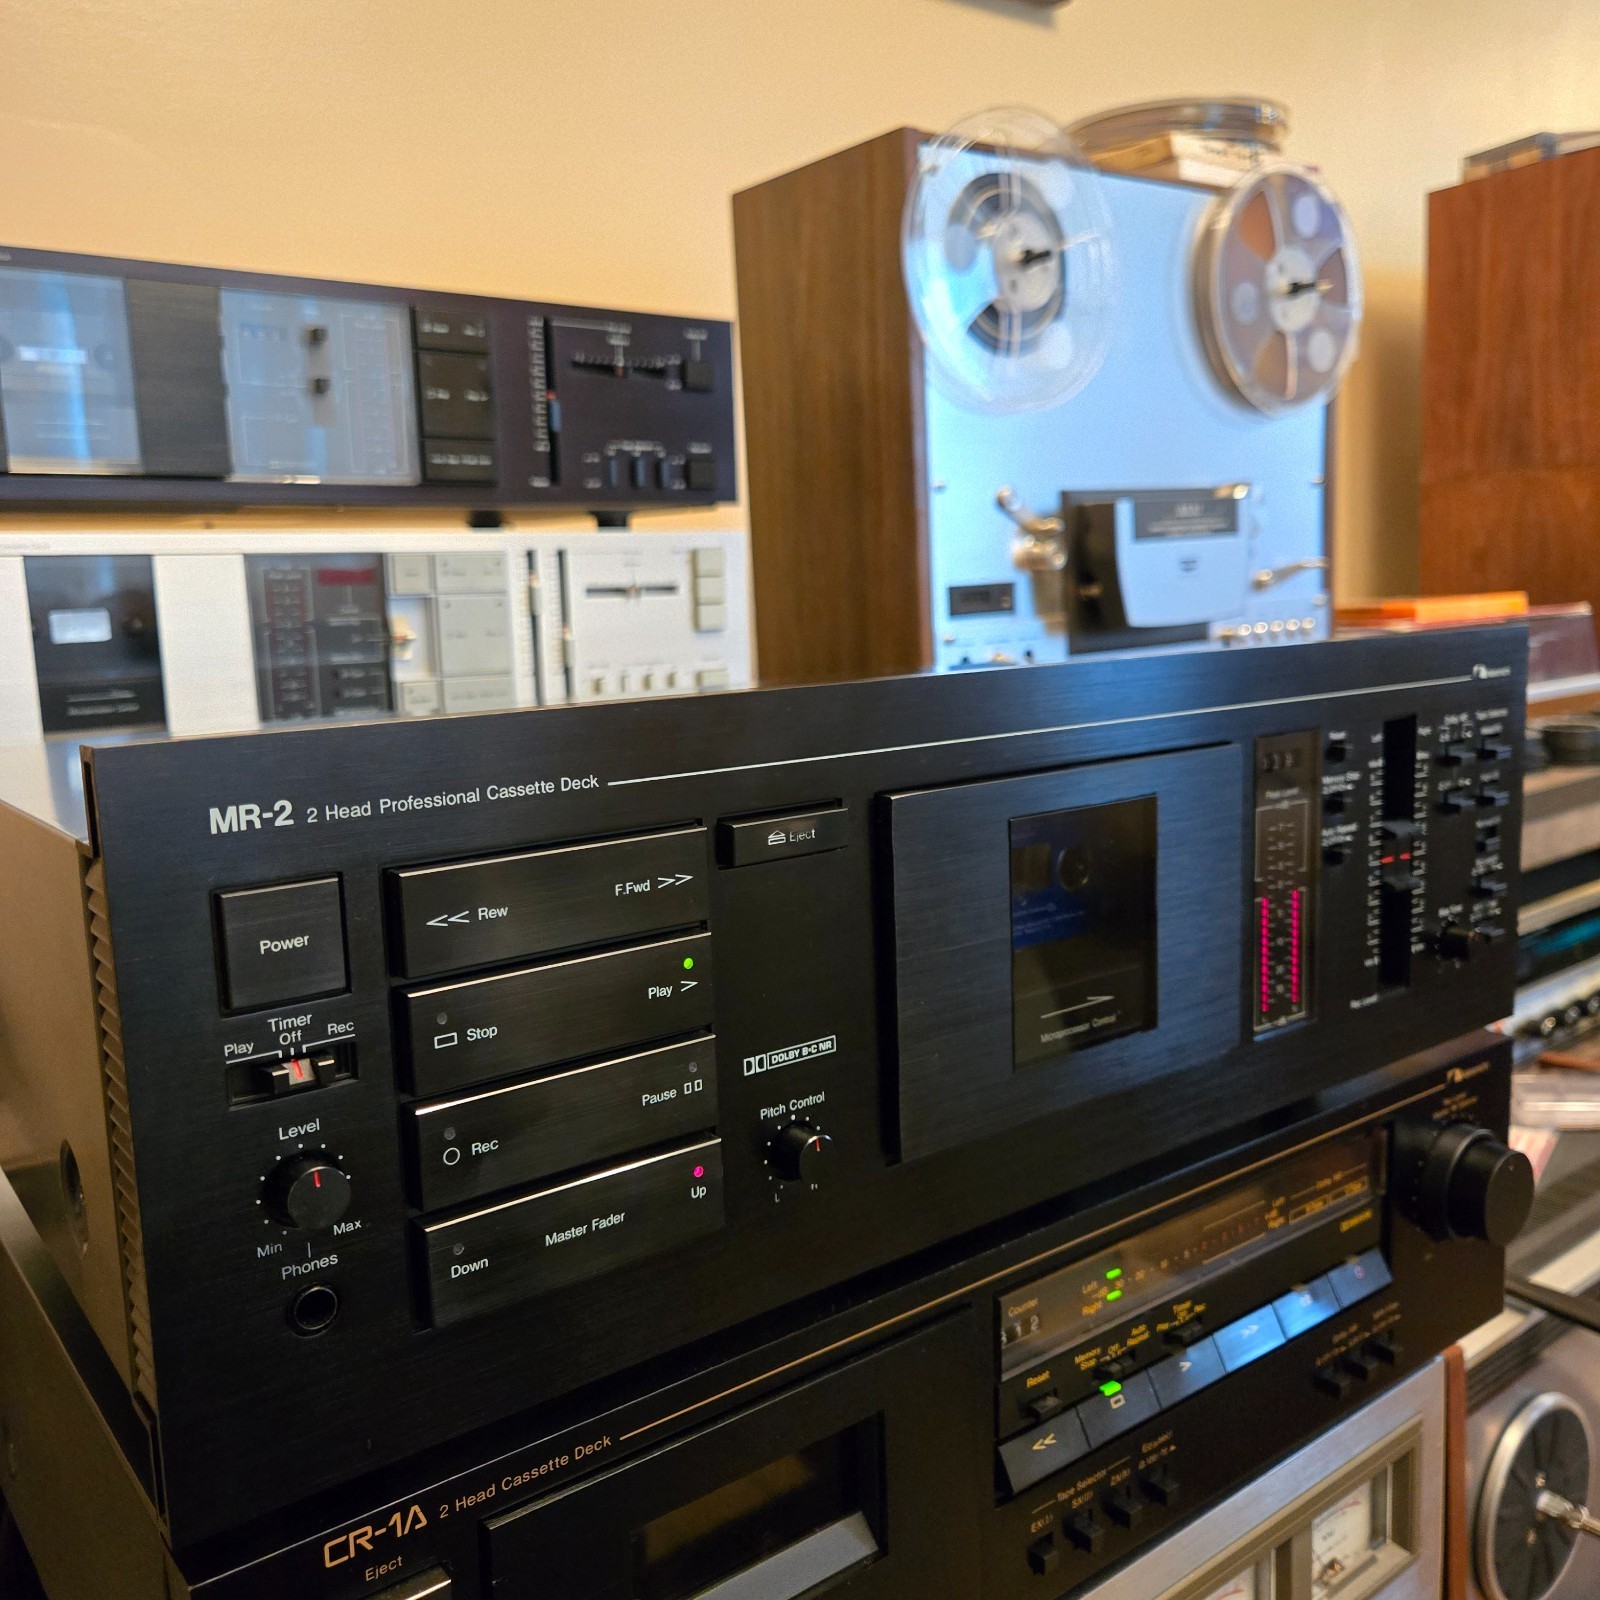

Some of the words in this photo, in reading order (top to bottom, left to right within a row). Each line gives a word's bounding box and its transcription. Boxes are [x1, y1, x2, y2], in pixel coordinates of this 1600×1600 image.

[209, 799, 295, 835] MR-2
[306, 807, 319, 824] 2
[326, 801, 372, 821] Head
[380, 788, 481, 814] Professional
[486, 780, 555, 801] Cassette
[561, 774, 600, 792] Deck
[789, 828, 816, 844] Eject
[477, 906, 509, 921] Rew
[259, 935, 310, 955] Power
[648, 985, 673, 1000] Play
[267, 1014, 313, 1032] Timer
[327, 1021, 355, 1036] Rec
[279, 1029, 302, 1046] Off
[466, 1026, 498, 1043] Stop
[223, 1042, 254, 1058] Play
[771, 1049, 800, 1065] DOLBY
[818, 1039, 832, 1051] NR
[641, 1088, 677, 1107] Pause
[760, 1103, 786, 1120] Pitch
[789, 1090, 825, 1111] Control
[278, 1117, 320, 1141] Level
[471, 1139, 499, 1156] Rec
[691, 1185, 707, 1201] Up
[333, 1219, 362, 1237] Max
[545, 1224, 588, 1247] Master
[591, 1212, 626, 1233] Fader
[256, 1243, 283, 1259] Min
[281, 1252, 339, 1281] Phones
[450, 1258, 489, 1279] Down
[323, 1503, 428, 1568] CR-1A
[439, 1504, 449, 1519] 2
[455, 1483, 496, 1512] Head
[500, 1454, 569, 1491] Cassette
[574, 1435, 612, 1461] Deck
[365, 1555, 403, 1582] Eject
